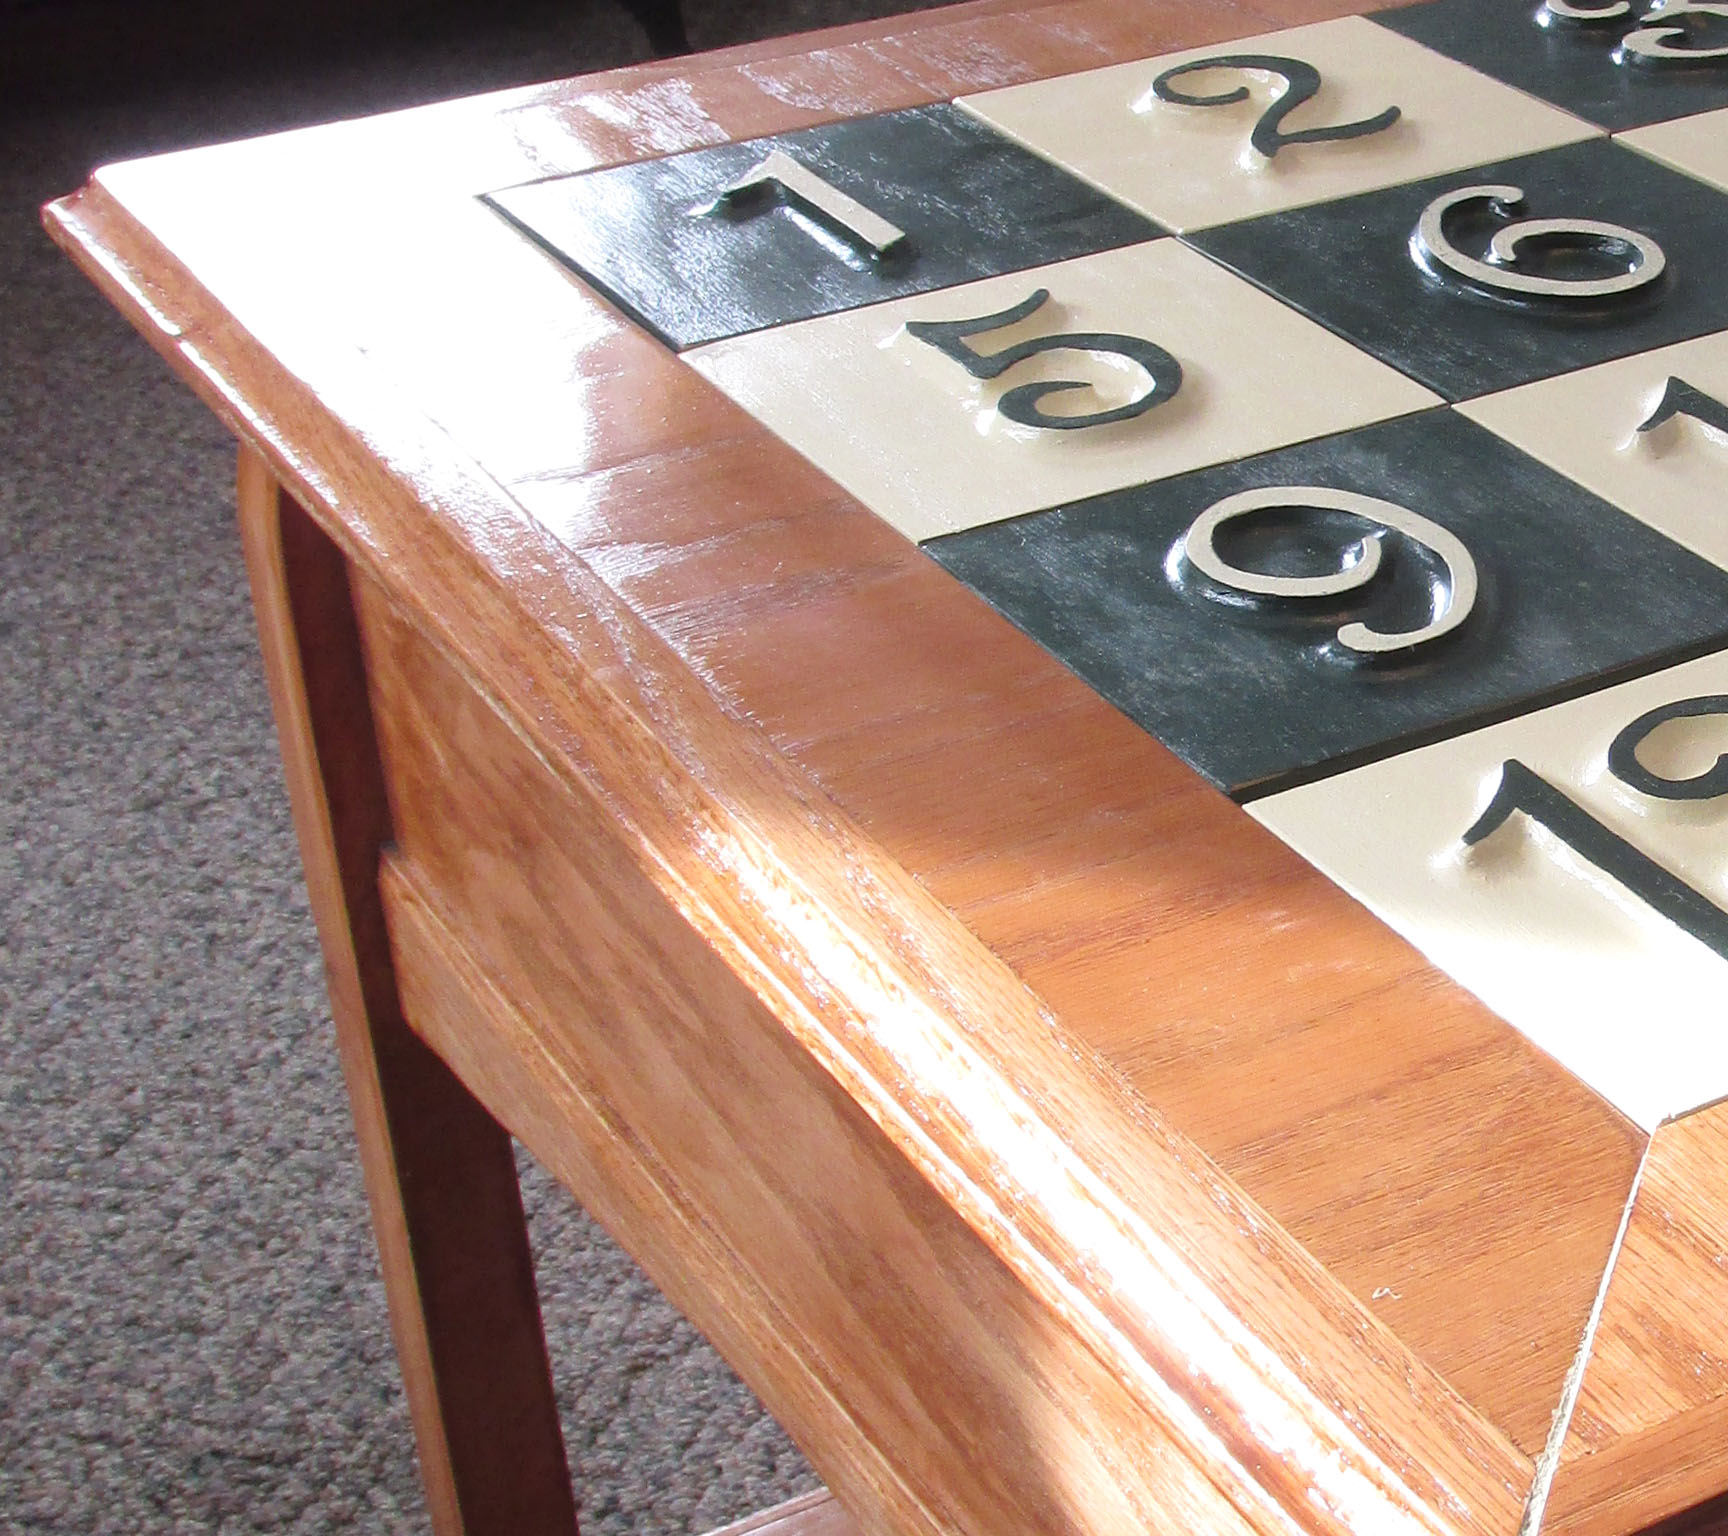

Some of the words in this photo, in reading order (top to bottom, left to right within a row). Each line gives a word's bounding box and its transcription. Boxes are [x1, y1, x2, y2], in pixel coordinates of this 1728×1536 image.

[1148, 53, 1401, 160] 2
[701, 152, 908, 265] 1
[1415, 184, 1667, 299] 6
[906, 289, 1183, 431] 5
[1179, 486, 1478, 656] 9
